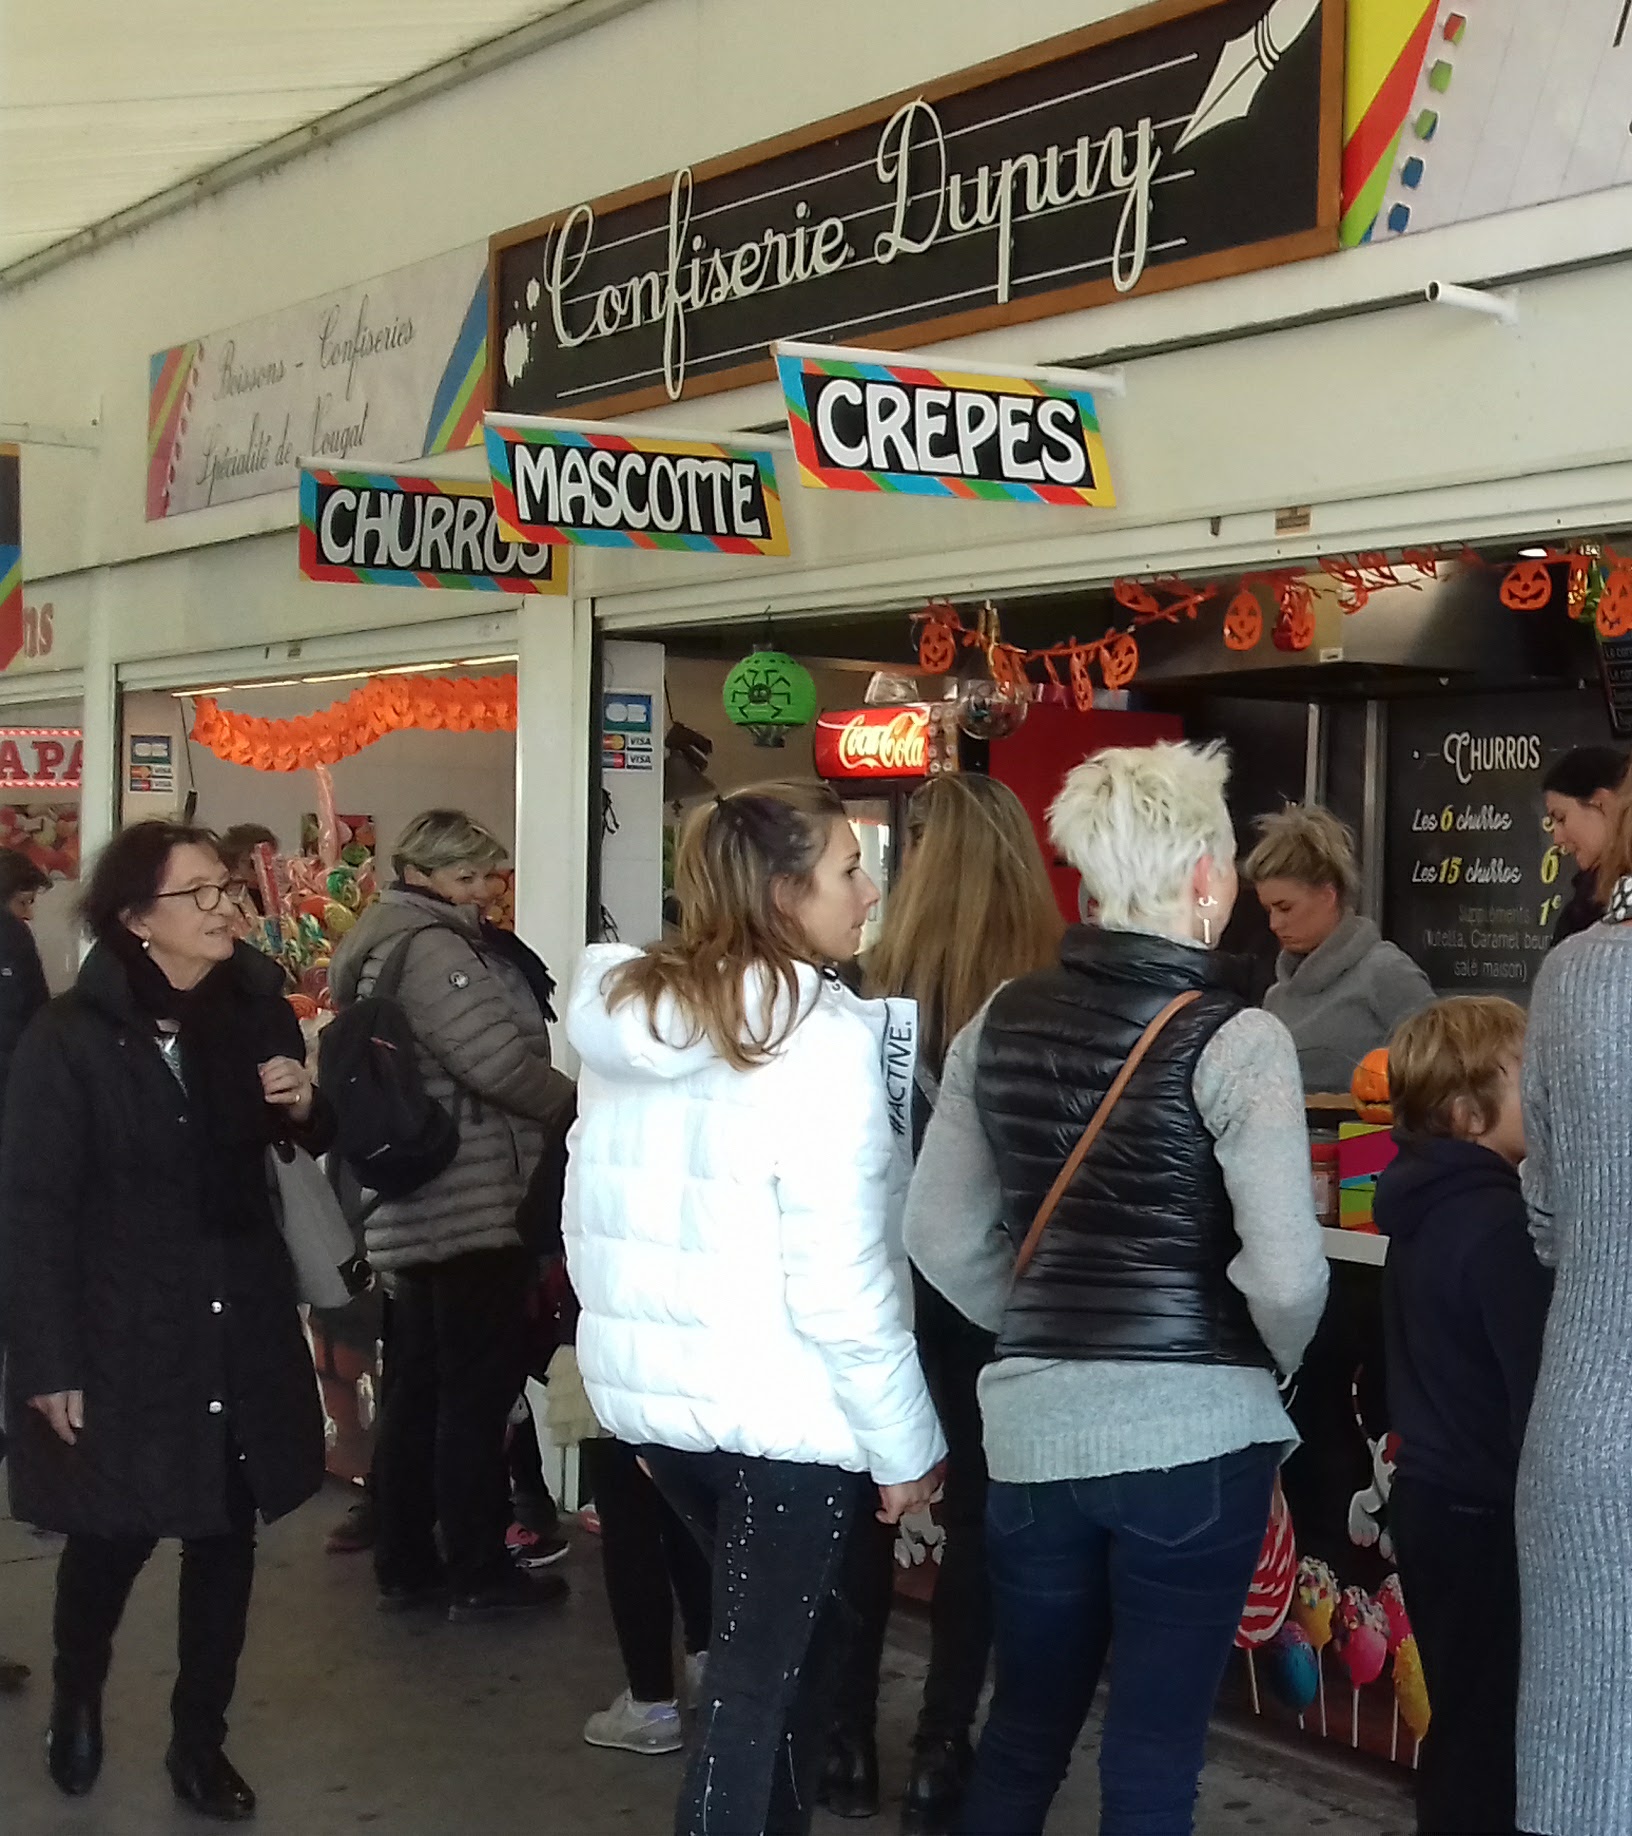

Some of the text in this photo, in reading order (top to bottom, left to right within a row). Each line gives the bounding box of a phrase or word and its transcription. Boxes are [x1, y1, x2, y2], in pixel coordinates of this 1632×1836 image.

[544, 97, 1163, 399] Confiserie Dupuy
[213, 339, 288, 401] Boissons
[319, 294, 414, 402] Confiseries
[274, 412, 293, 467] de
[816, 378, 1087, 485] CREPES
[512, 444, 763, 538] MASCOTTE
[629, 736, 652, 747] VISA
[629, 754, 652, 765] VISA
[1412, 808, 1438, 832] Les
[1440, 804, 1454, 832] 6
[1456, 804, 1513, 832] churros
[1412, 857, 1438, 884] Les
[1438, 856, 1463, 885] 15
[1465, 857, 1523, 885] churros
[1470, 927, 1520, 949] Caramel
[1454, 958, 1528, 983] salé maison)
